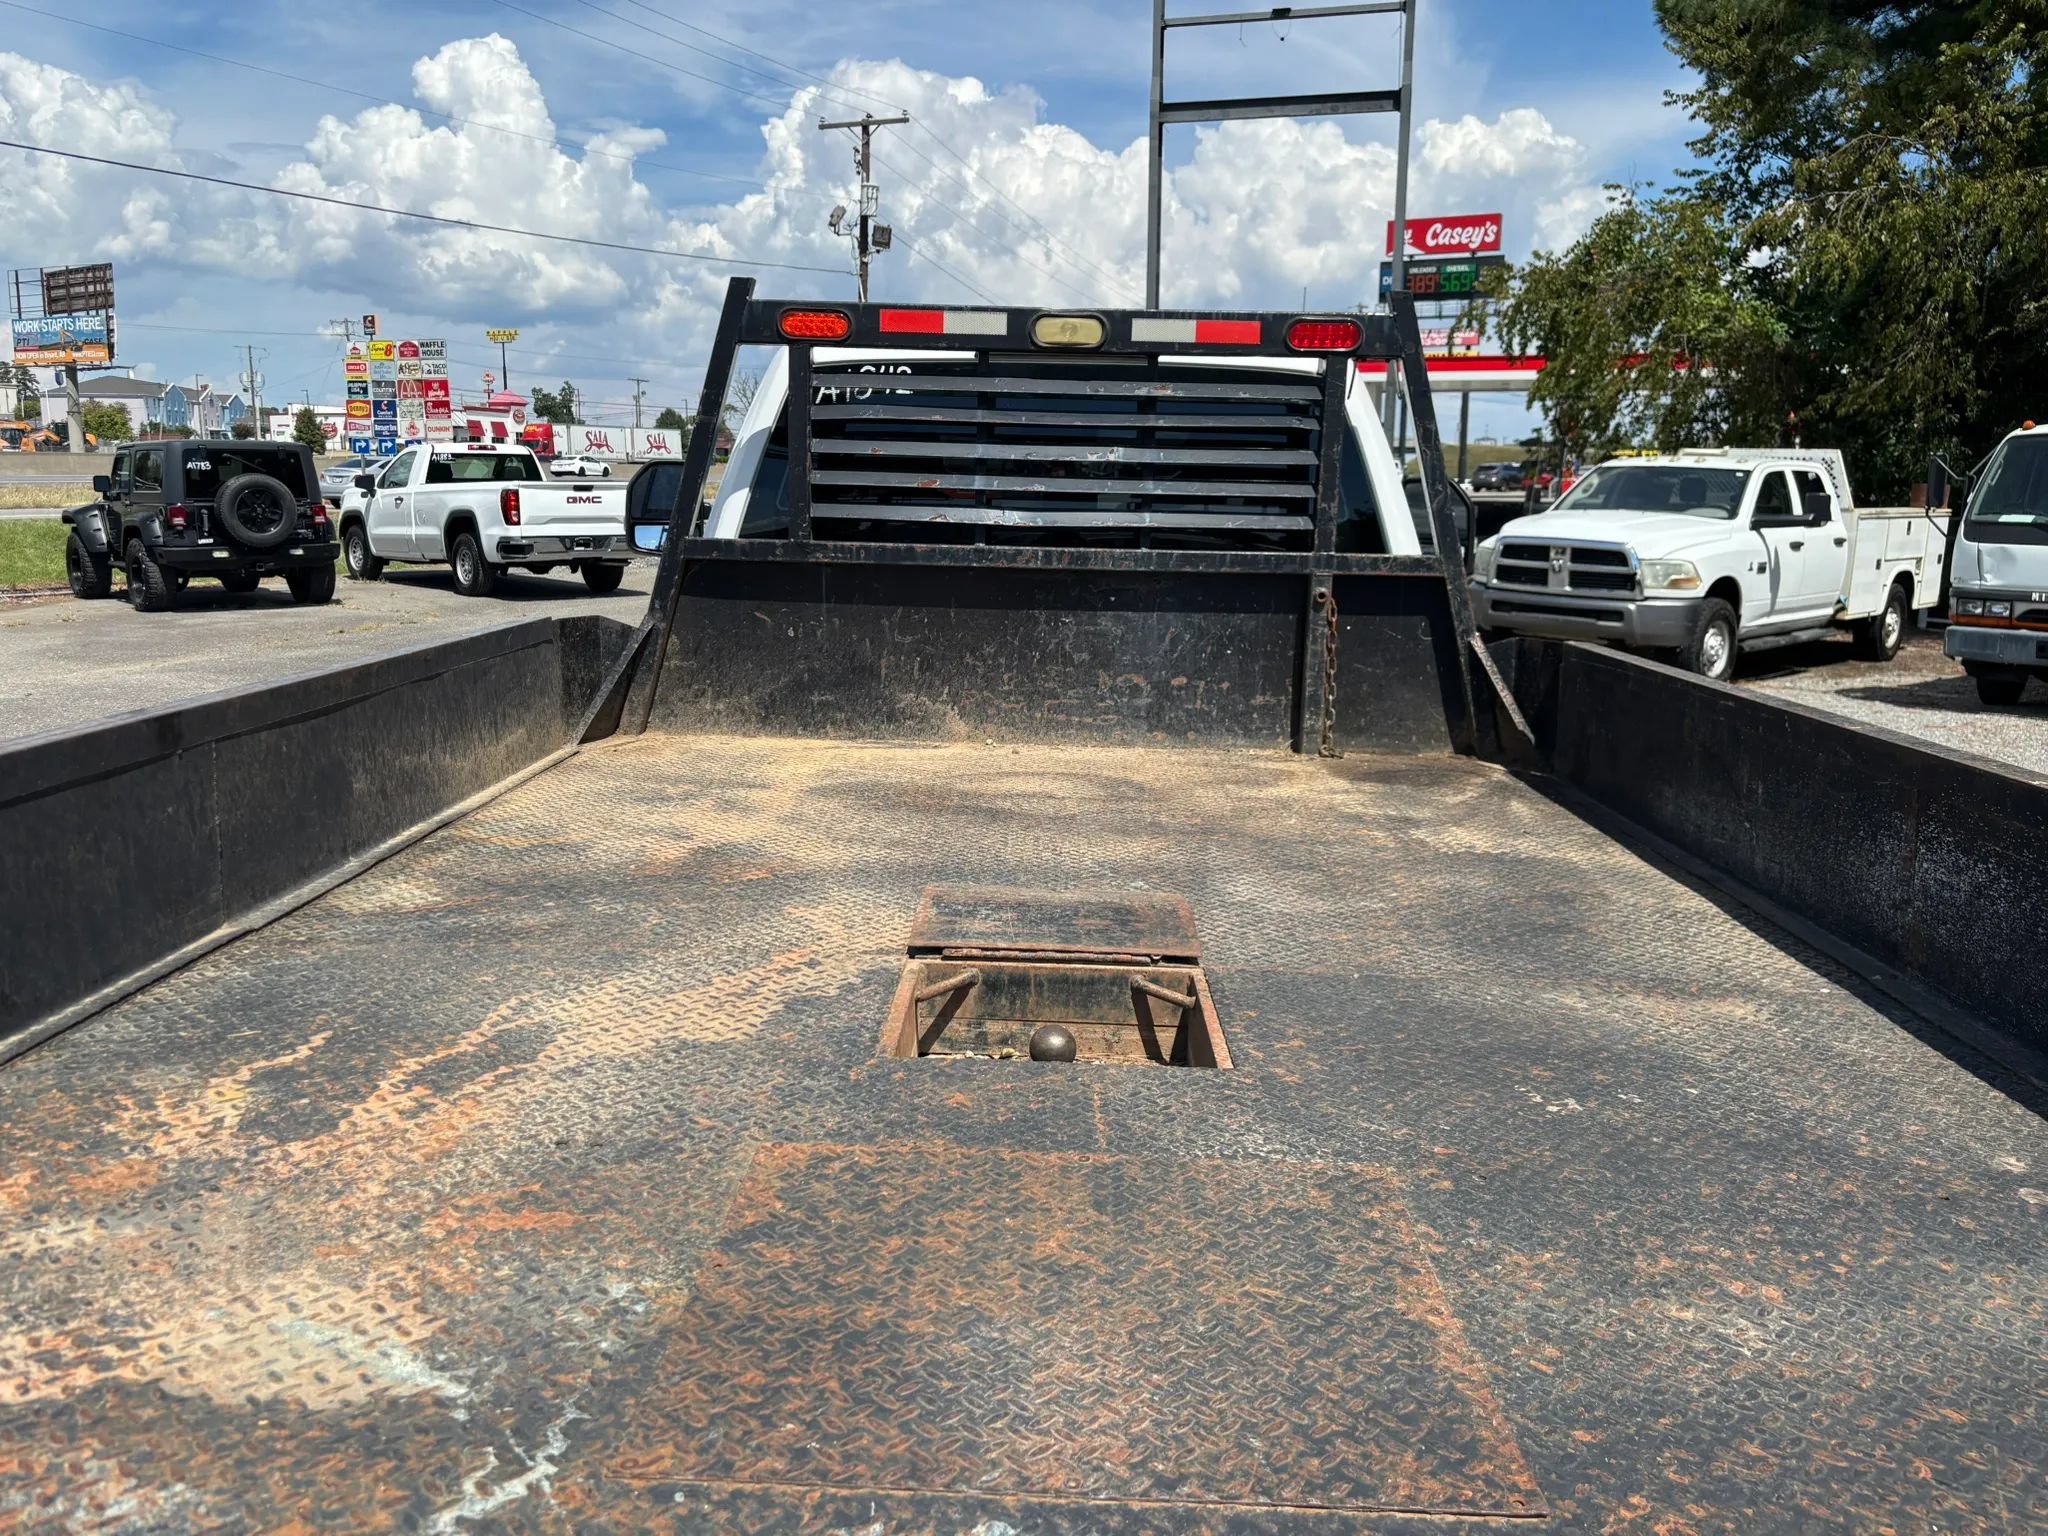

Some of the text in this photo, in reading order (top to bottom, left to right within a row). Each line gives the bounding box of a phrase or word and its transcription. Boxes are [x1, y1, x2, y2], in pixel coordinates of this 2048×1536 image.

[1425, 221, 1498, 248] Casey's
[14, 316, 104, 333] WORK STARTS HERE.
[585, 430, 614, 453] SAIA
[646, 432, 671, 454] SAIA
[566, 496, 602, 504] GMC
